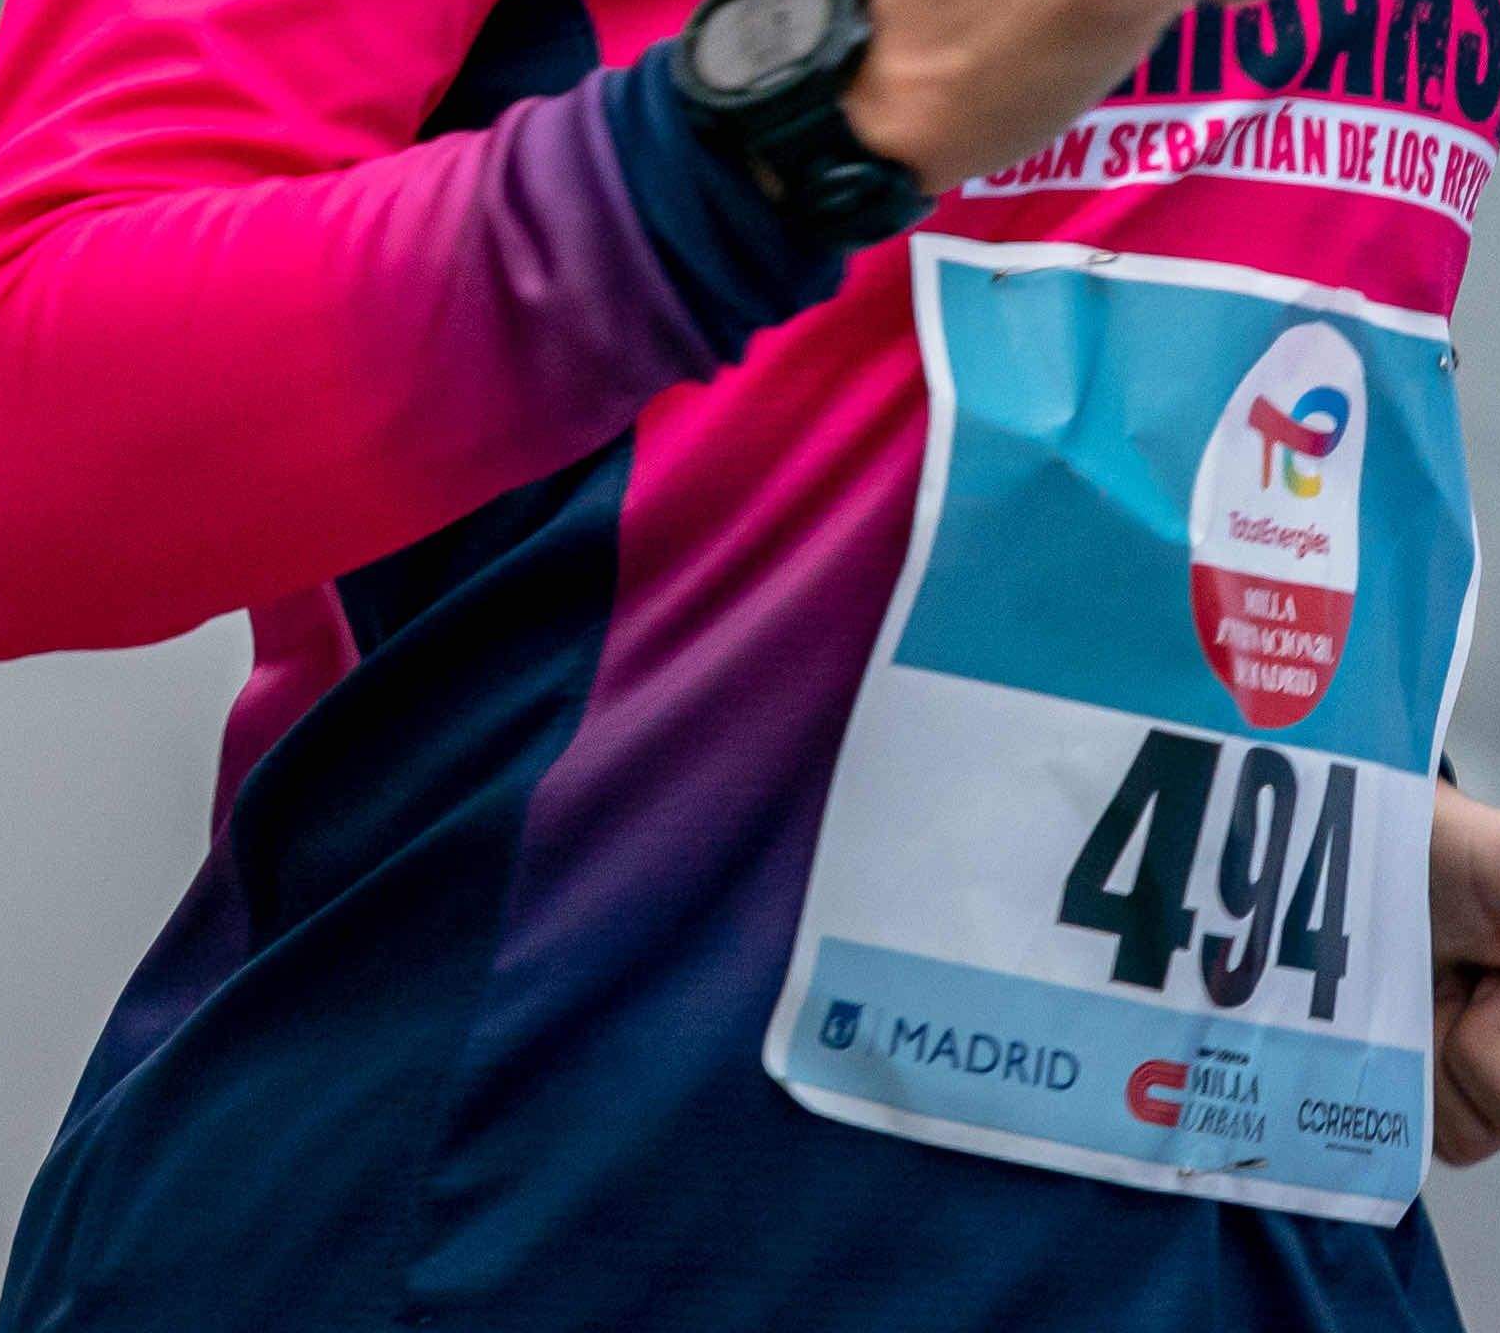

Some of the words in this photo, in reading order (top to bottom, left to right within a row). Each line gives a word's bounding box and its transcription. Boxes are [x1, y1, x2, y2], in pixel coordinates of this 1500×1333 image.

[1338, 121, 1379, 182] DE
[1382, 127, 1440, 198] LOS
[1057, 728, 1358, 1021] 494
[888, 1016, 1081, 1091] MADRID
